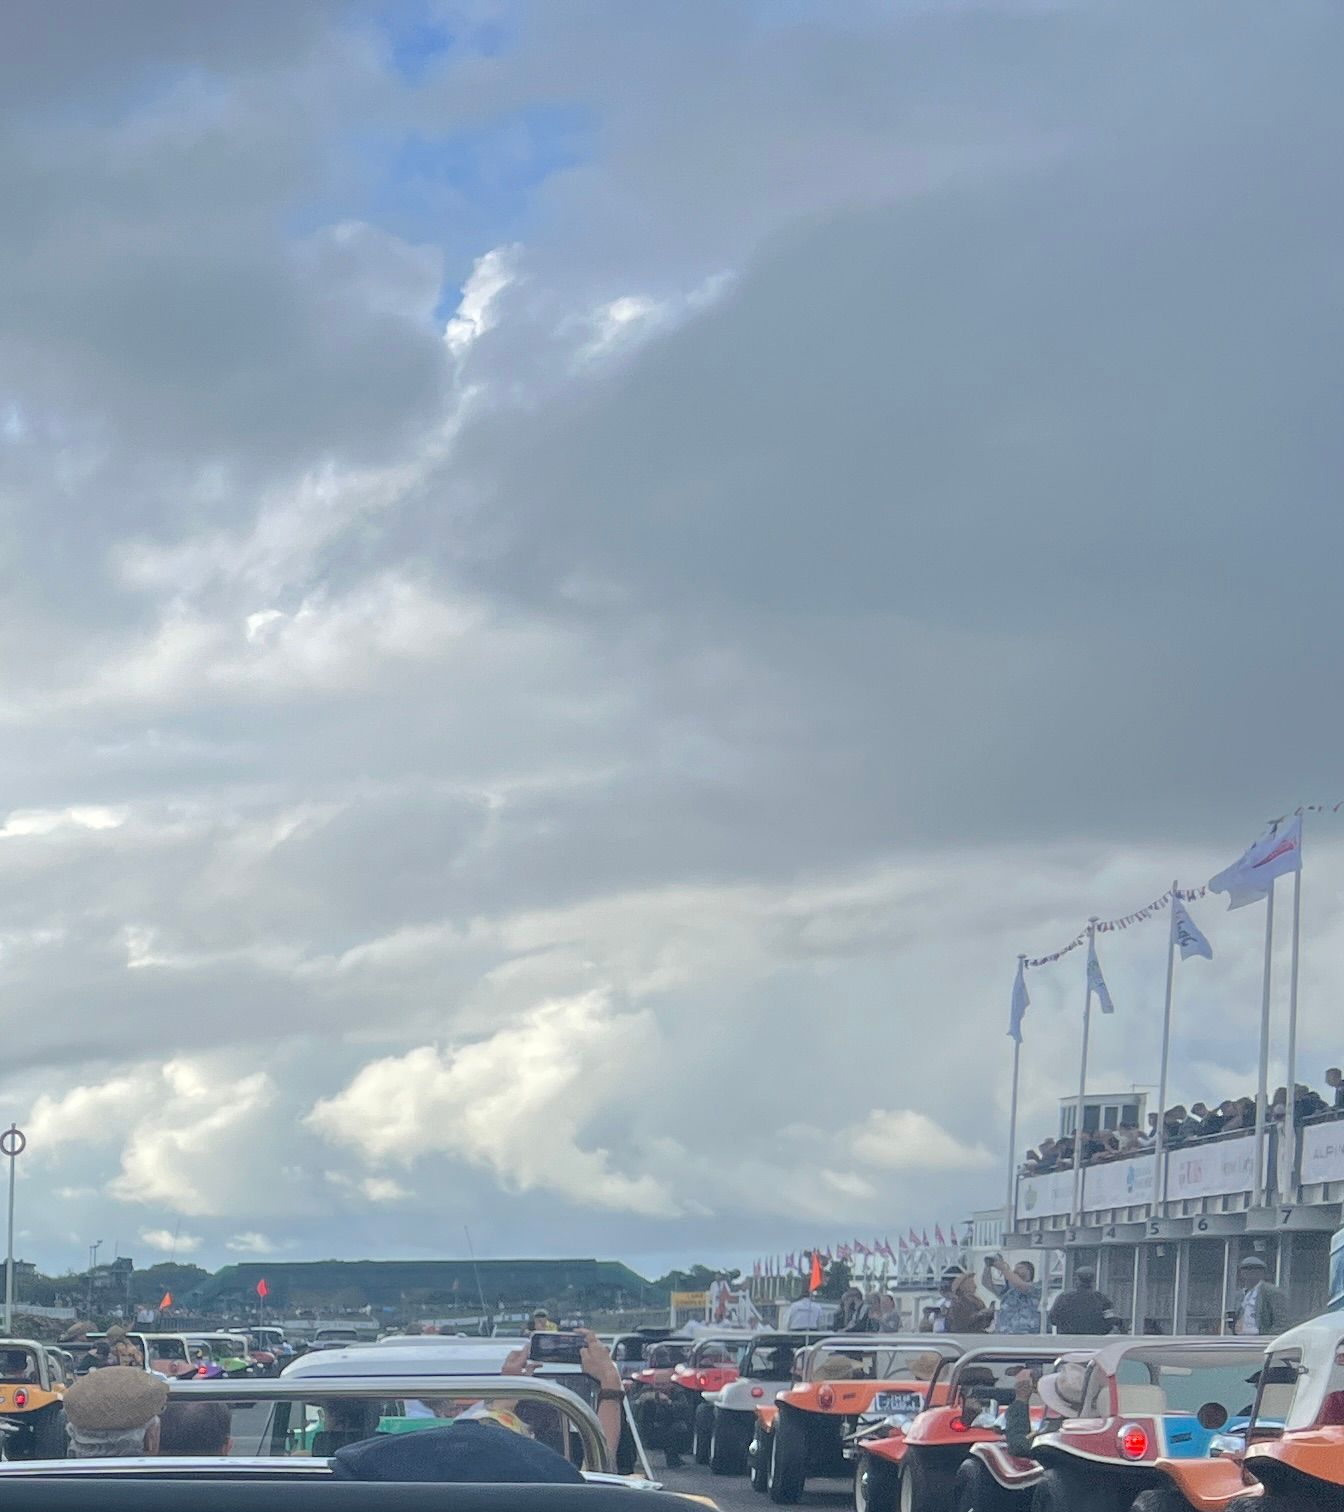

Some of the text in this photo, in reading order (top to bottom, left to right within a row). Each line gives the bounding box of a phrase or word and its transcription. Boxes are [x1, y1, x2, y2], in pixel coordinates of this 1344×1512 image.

[1280, 1208, 1292, 1225] 7
[1150, 1222, 1160, 1235] 5
[1198, 1218, 1208, 1231] 6
[1034, 1233, 1043, 1245] 2
[1067, 1230, 1076, 1242] 3
[1106, 1227, 1116, 1239] 4
